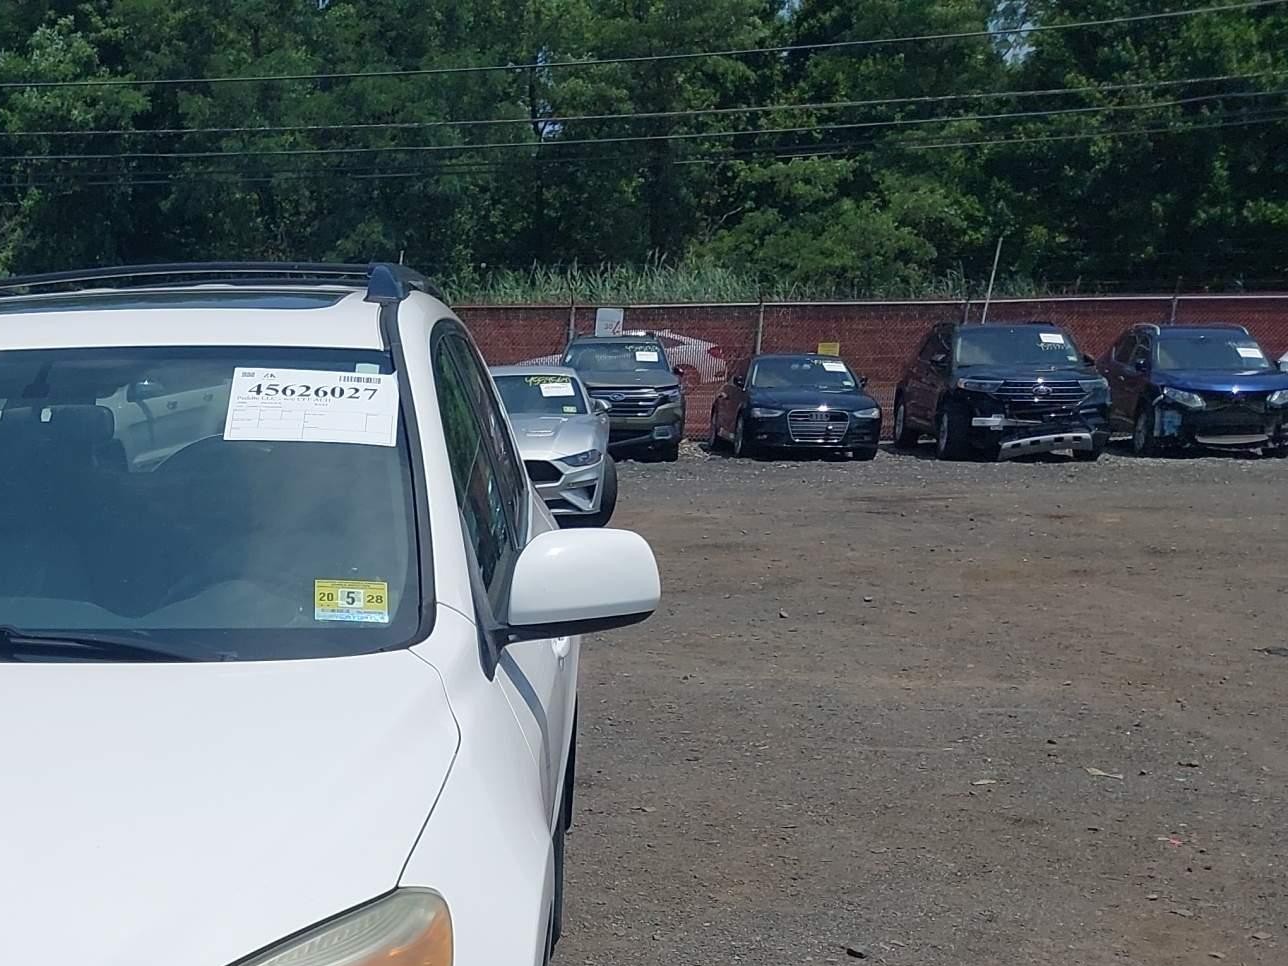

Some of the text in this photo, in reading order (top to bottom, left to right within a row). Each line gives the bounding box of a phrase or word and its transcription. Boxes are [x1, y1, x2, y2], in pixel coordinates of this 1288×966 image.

[247, 382, 379, 401] 45626027
[319, 591, 384, 606] 20 5 28
